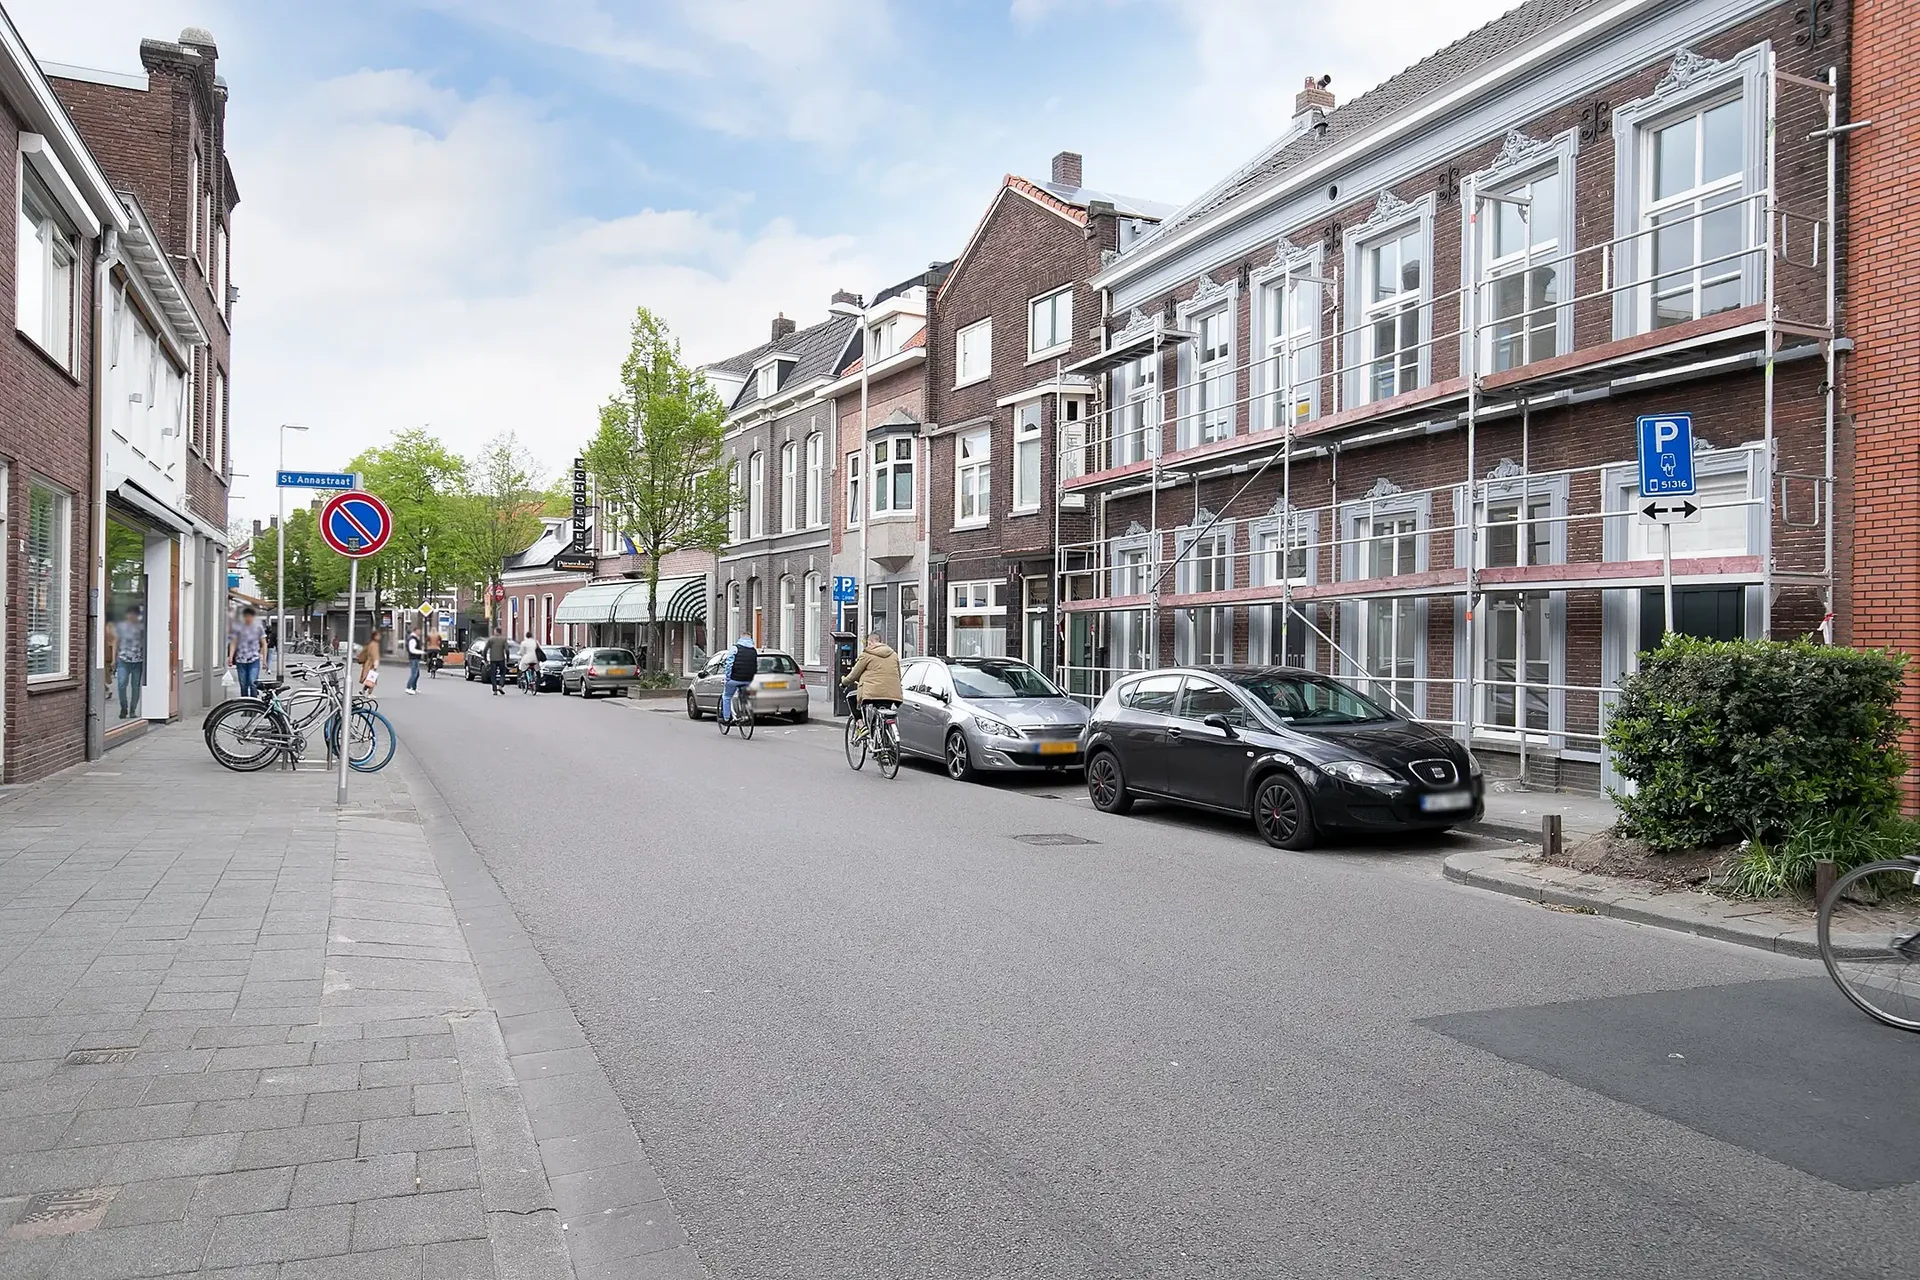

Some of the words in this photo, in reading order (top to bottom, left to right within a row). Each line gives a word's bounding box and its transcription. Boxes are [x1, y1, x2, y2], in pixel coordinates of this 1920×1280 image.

[1655, 421, 1679, 453] P
[281, 475, 295, 484] St.
[296, 475, 351, 486] Annastraat
[1661, 480, 1688, 489] 51316
[575, 461, 585, 551] SCHOENEN
[842, 578, 852, 592] P
